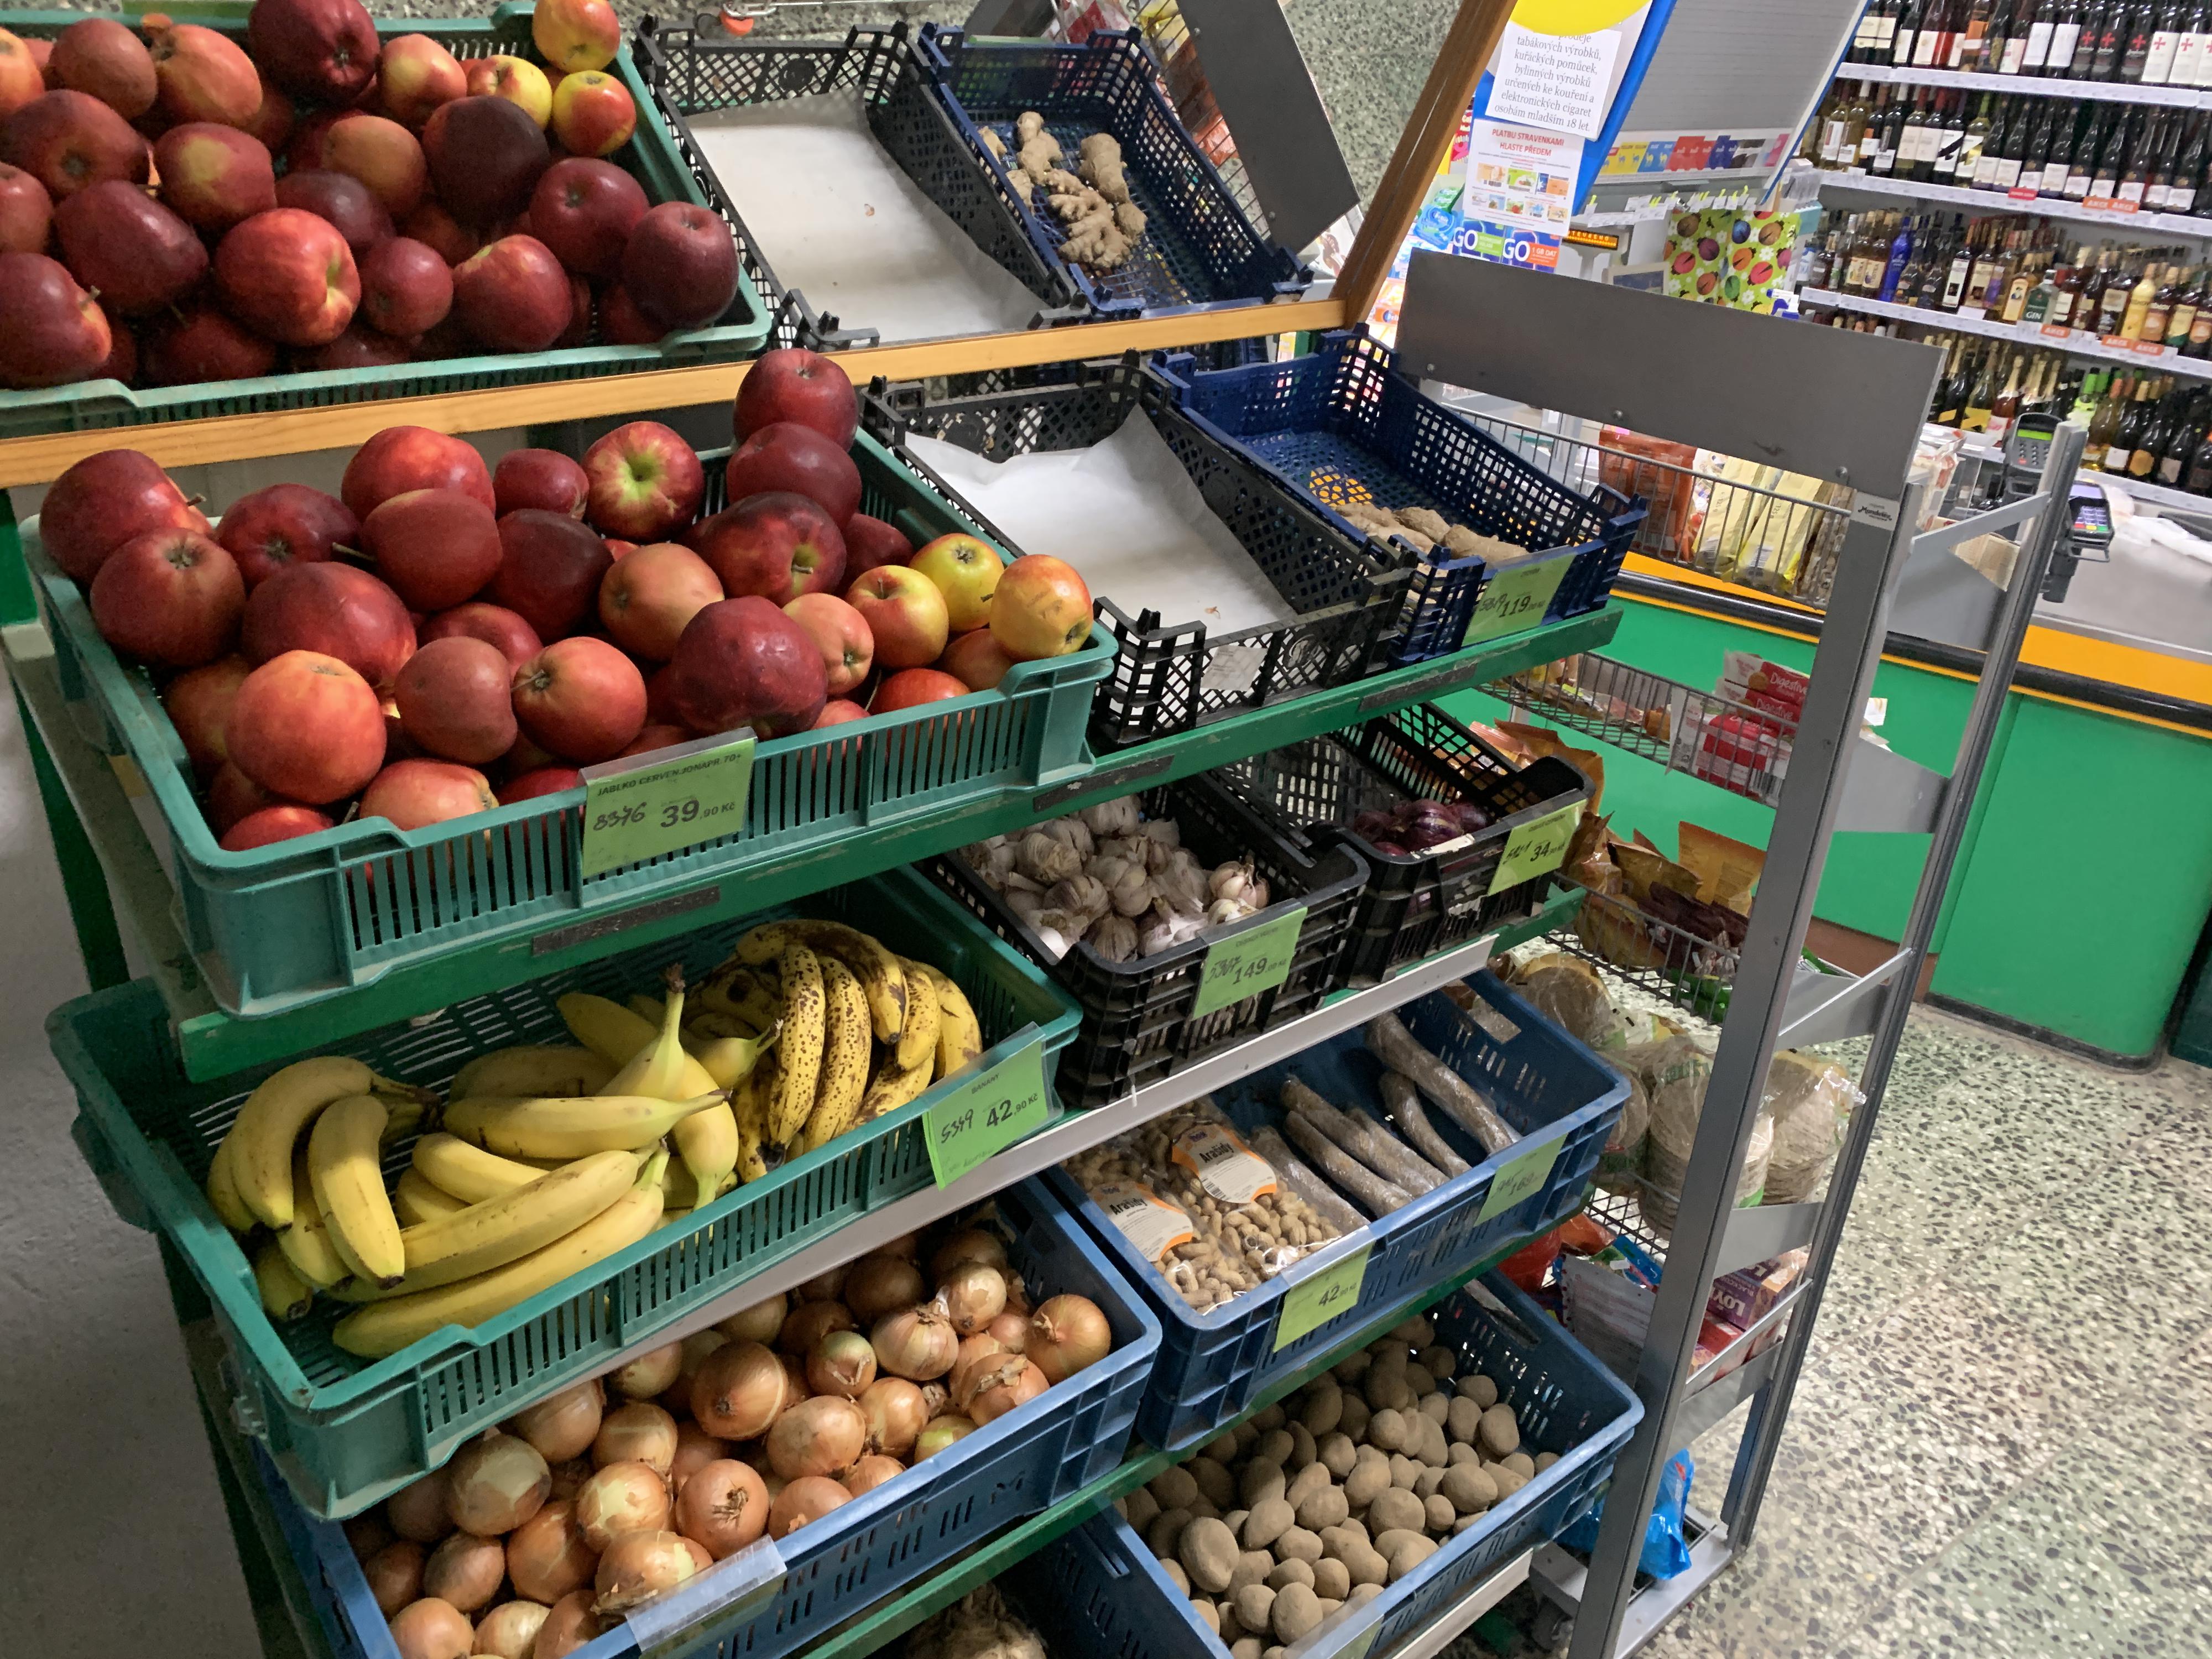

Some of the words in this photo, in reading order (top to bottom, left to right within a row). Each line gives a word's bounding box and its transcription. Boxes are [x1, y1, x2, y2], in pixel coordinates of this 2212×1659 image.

[1517, 35, 1562, 53] tabákových
[1565, 44, 1601, 61] výrobků,
[1514, 49, 1554, 66] kuřáckých
[1556, 59, 1598, 75] pomůcek,
[1515, 63, 1554, 81] bylinných
[1557, 72, 1590, 87] výrobků
[1505, 77, 1541, 93] určených
[1543, 84, 1553, 95] ke
[1554, 86, 1588, 102] kouření
[1589, 95, 1594, 103] a
[1501, 90, 1561, 111] elektronických
[1563, 104, 1592, 117] cigaret
[1495, 104, 1525, 117] osobám
[1528, 111, 1564, 126] mladším
[1567, 118, 1577, 128] 18
[1579, 119, 1590, 132] let.
[1492, 128, 1516, 139] PLATBU
[1517, 132, 1564, 147] STRAVENKAMI
[1500, 142, 1523, 153] HLASTE
[1524, 144, 1552, 156] PŘEDEM
[1453, 227, 1479, 250] GO
[1503, 238, 1531, 262] GO
[2026, 311, 2042, 320] GIN
[1770, 671, 1808, 695] Digestive
[597, 780, 637, 796] JABLKO
[721, 801, 735, 812] Kč
[1029, 1092, 1039, 1105] Kč
